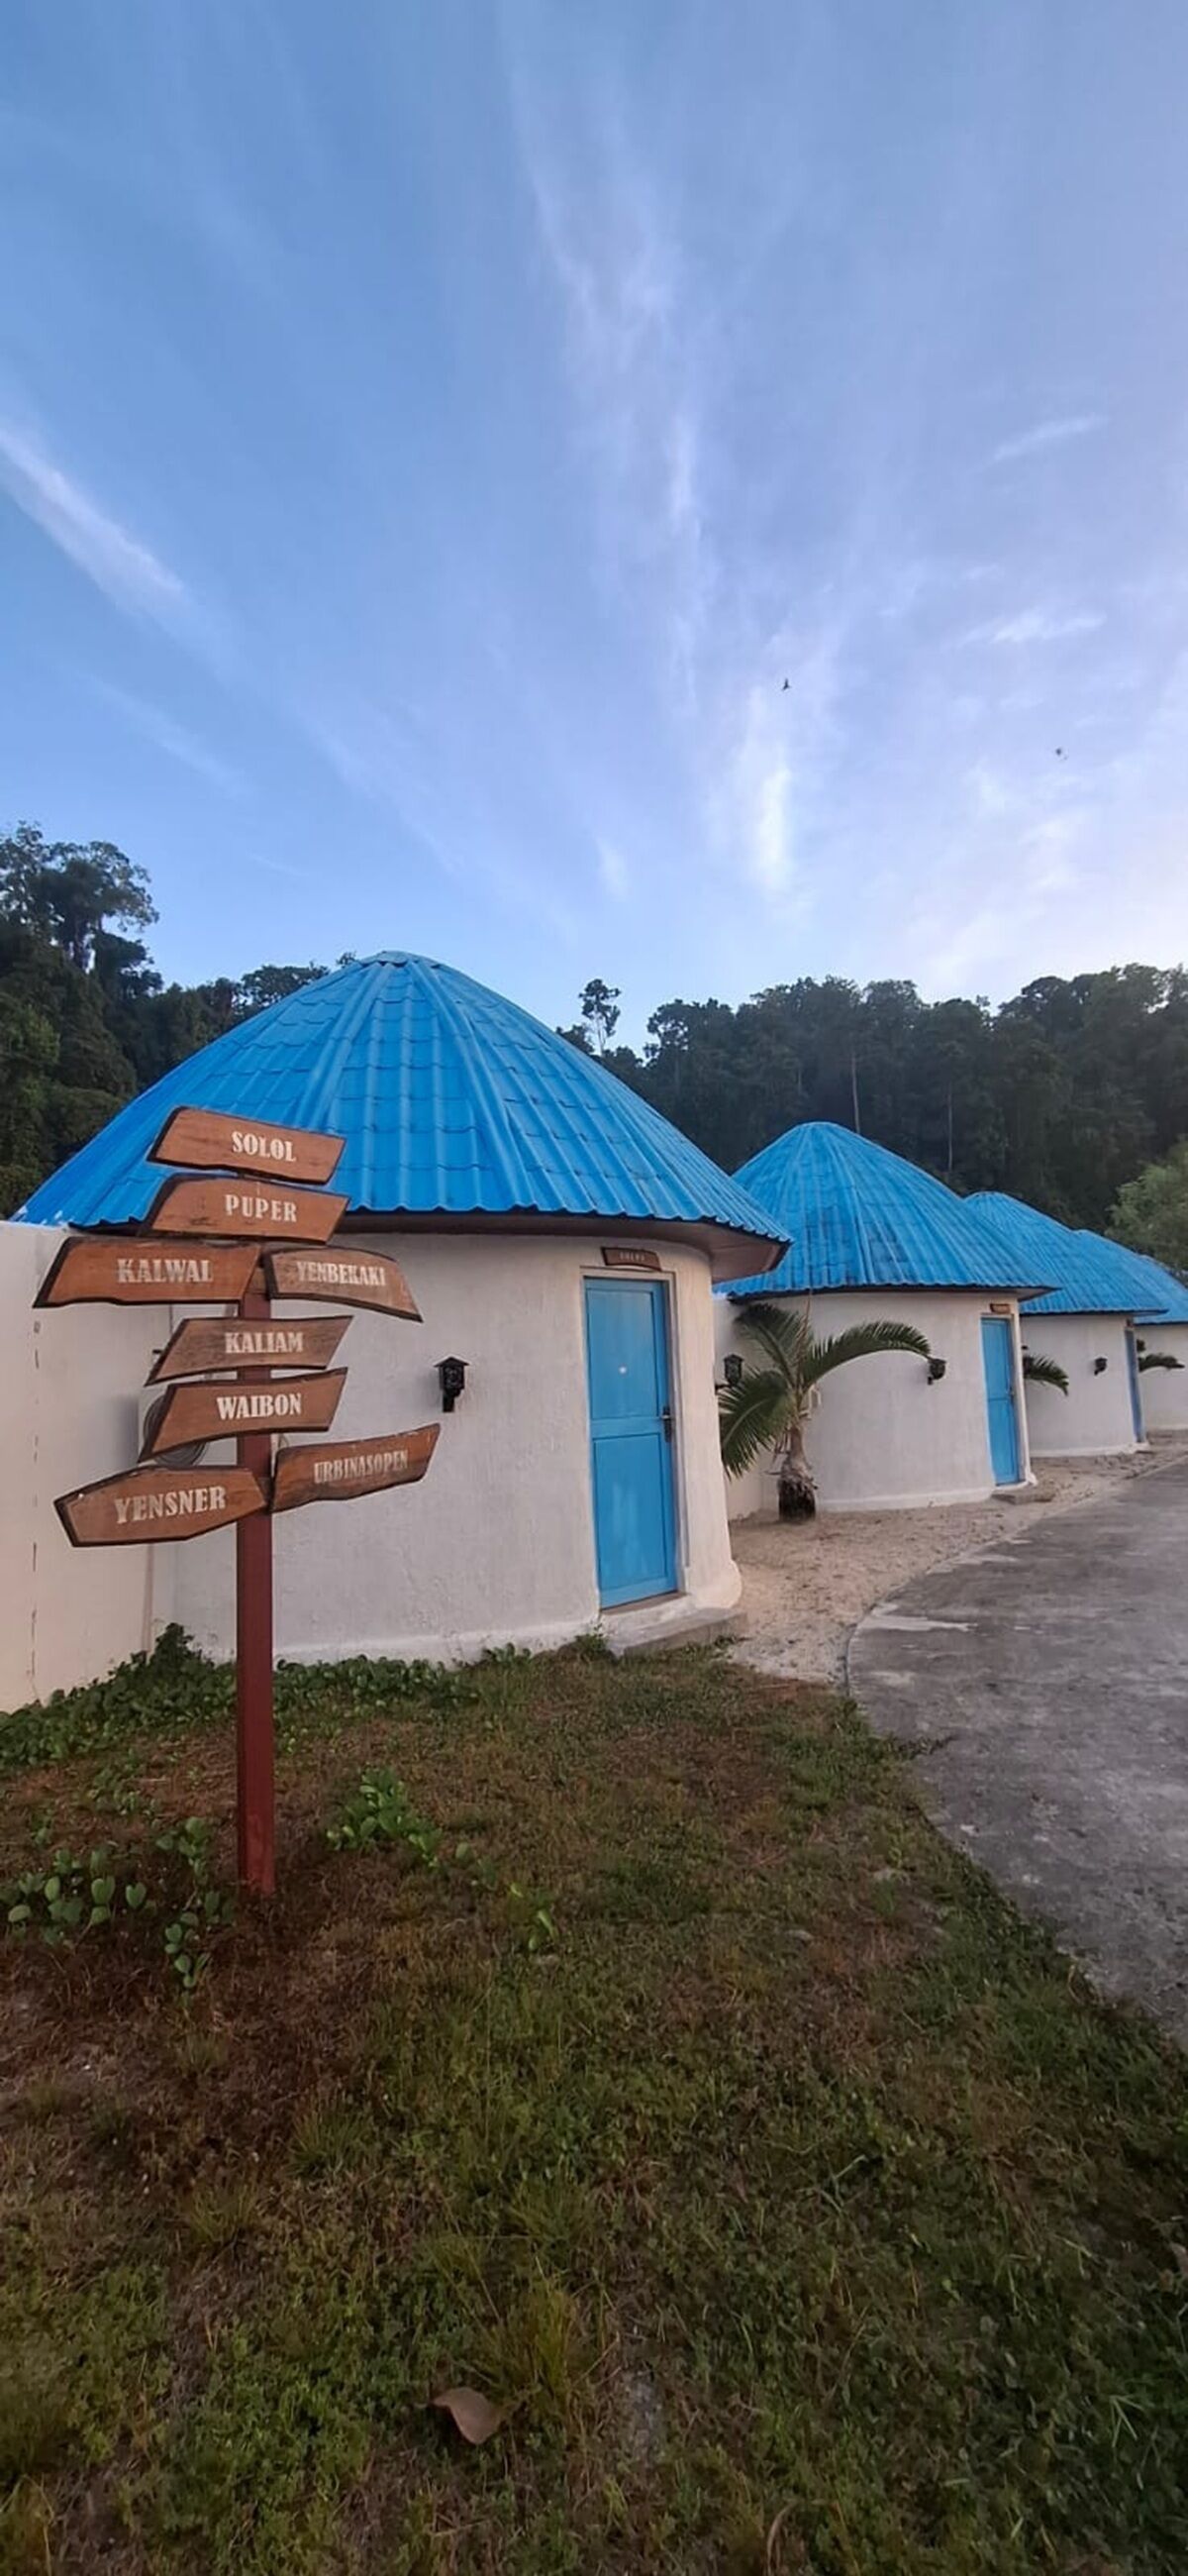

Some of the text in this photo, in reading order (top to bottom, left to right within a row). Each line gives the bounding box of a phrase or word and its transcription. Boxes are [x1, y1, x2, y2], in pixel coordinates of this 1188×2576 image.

[231, 1131, 296, 1162] SOLOL
[225, 1194, 297, 1222] PUPER
[117, 1259, 214, 1284] KALWAL
[296, 1261, 386, 1287] YENBEKAKI
[225, 1332, 303, 1354] KALIAM
[216, 1392, 302, 1420] WAIBON
[313, 1450, 408, 1484] URBINASOPEN
[114, 1487, 227, 1523] YENSNER
